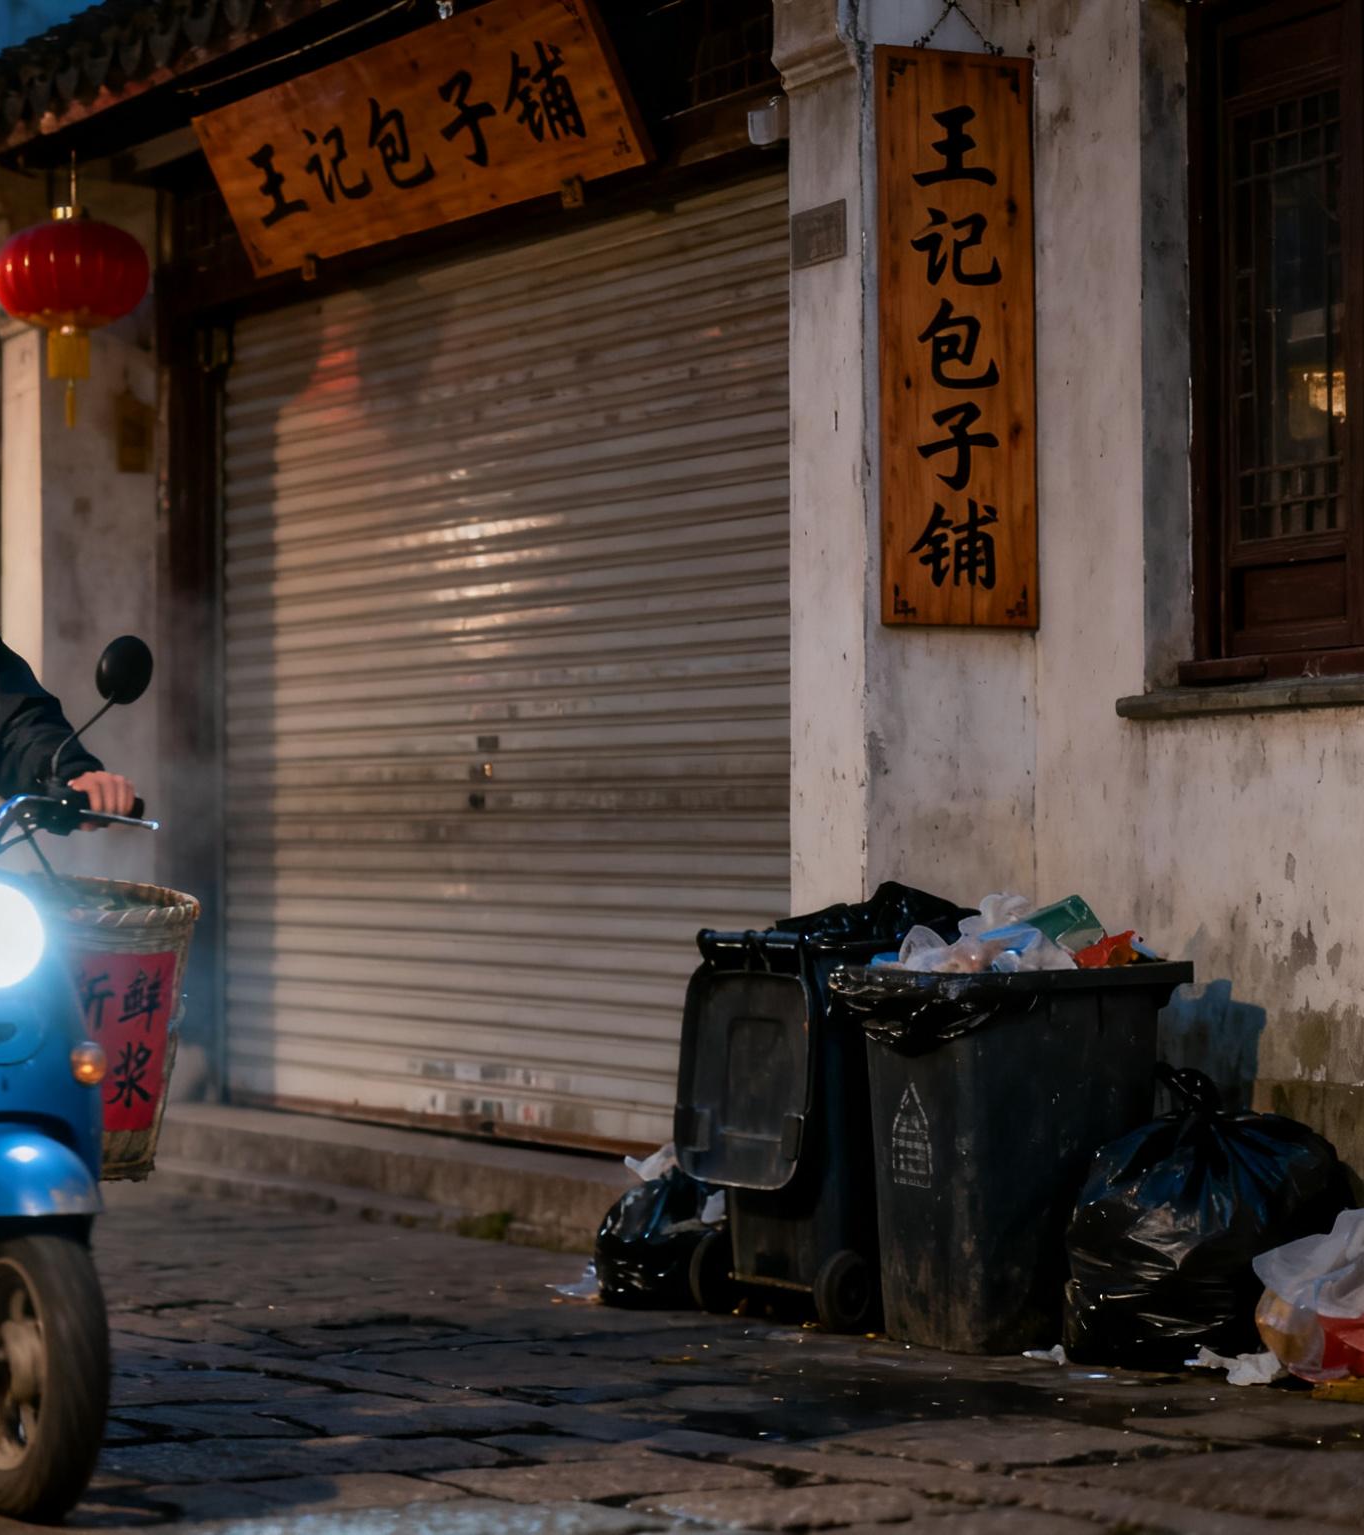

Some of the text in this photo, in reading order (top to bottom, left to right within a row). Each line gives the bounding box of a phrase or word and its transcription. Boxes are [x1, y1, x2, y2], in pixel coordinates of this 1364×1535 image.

[248, 40, 587, 228] 王记包子铺
[908, 105, 1003, 591] 王记包子铺
